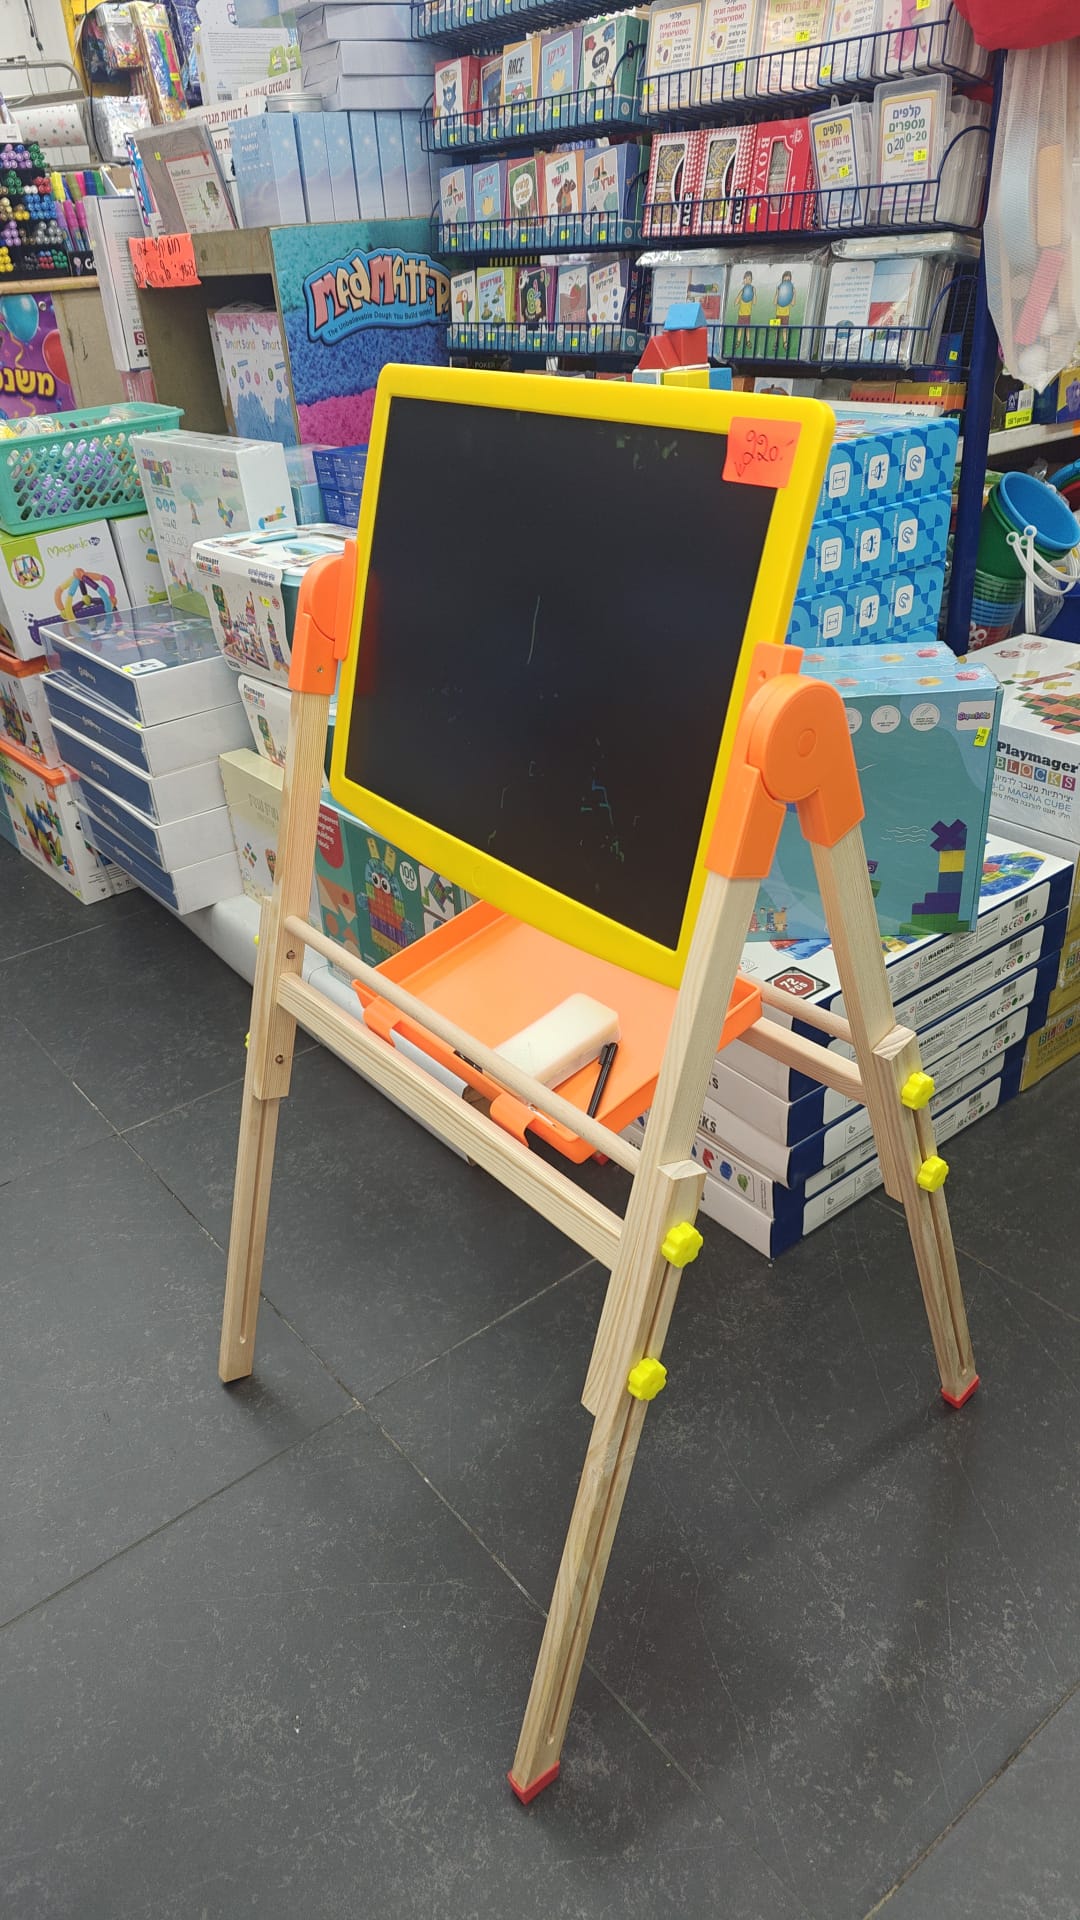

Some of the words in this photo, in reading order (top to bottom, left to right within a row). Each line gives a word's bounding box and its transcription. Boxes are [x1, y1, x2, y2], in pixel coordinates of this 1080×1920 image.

[507, 56, 524, 76] RACE
[892, 104, 921, 120] קלפים
[823, 121, 843, 137] קלפים
[889, 118, 926, 133] מספרים
[905, 130, 927, 142] 0-20
[894, 137, 904, 152] 20
[328, 327, 338, 337] The
[339, 313, 373, 331] Unbelievable
[374, 310, 392, 321] Dough
[393, 311, 404, 320] You
[404, 310, 418, 320] Build
[0, 367, 56, 397] משנ
[997, 740, 1079, 774] Playmager
[996, 756, 1076, 791] BLOCKS
[1020, 781, 1039, 793] מעבר
[1008, 786, 1042, 802] MAGNA
[1044, 797, 1073, 812] CUBE
[401, 863, 416, 882] 100
[779, 977, 799, 989] 72
[788, 982, 808, 994] PCS
